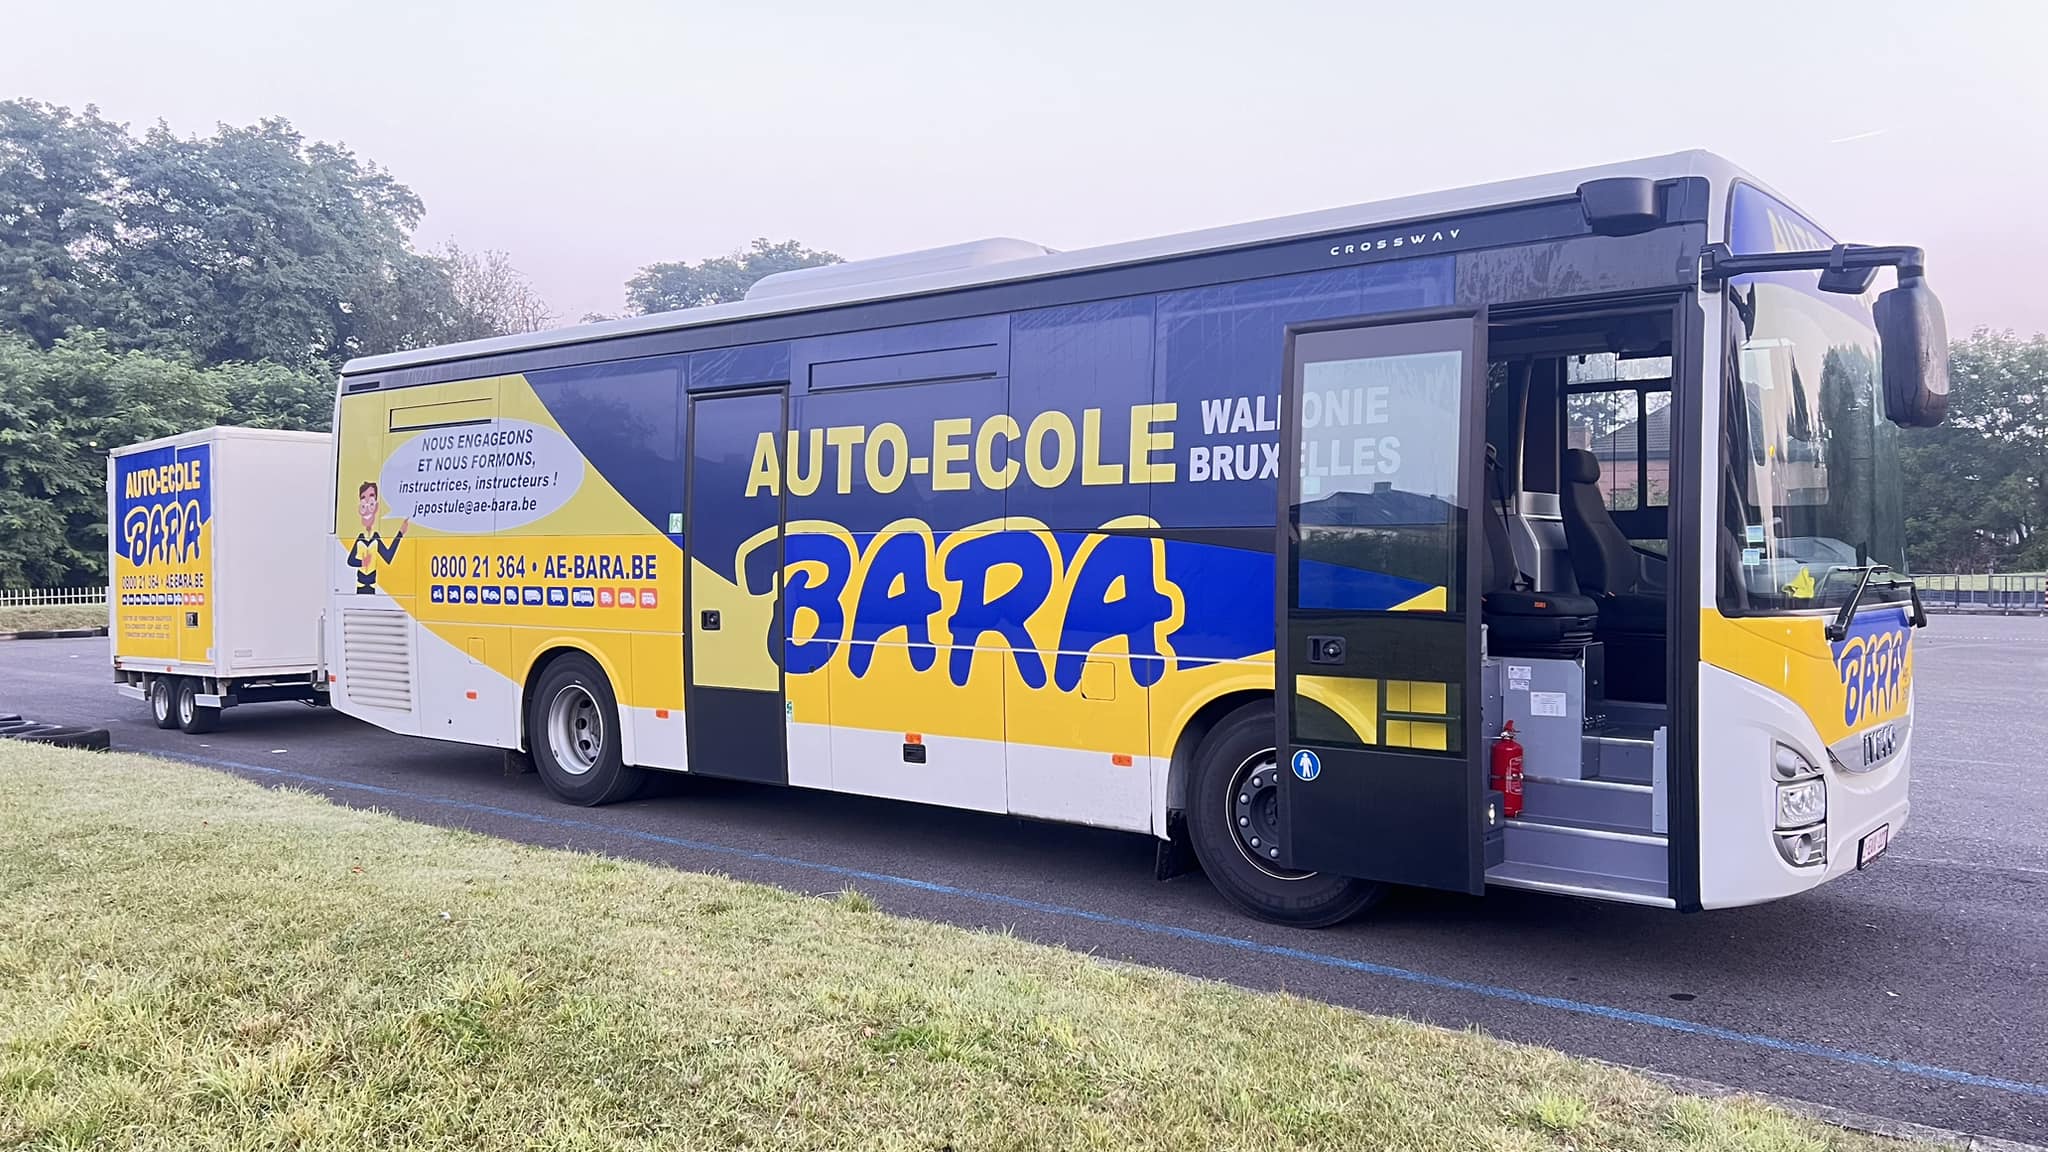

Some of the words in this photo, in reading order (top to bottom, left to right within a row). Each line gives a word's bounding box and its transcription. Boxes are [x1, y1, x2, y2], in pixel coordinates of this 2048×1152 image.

[1201, 386, 1390, 435] WALONIE
[422, 436, 454, 452] NOUS
[457, 429, 534, 449] ENGAGEONS
[744, 402, 1177, 497] AUTO-ECOLE
[1189, 436, 1400, 482] BRUXLLES
[125, 460, 201, 499] AUTO-ECOLE
[418, 458, 432, 473] ET
[435, 457, 467, 471] NOUS
[471, 451, 536, 470] FORMONS,
[399, 474, 471, 494] instructrices,
[475, 473, 549, 491] instructeurs
[413, 498, 537, 517] jepostule@ae-bara.be
[124, 499, 201, 567] BARA
[431, 555, 466, 578] 0800
[472, 555, 489, 578] 21
[496, 555, 526, 579] 364
[544, 554, 657, 580] AE-BARA.BE
[736, 515, 1184, 692] BARA
[1839, 629, 1903, 726] BARA
